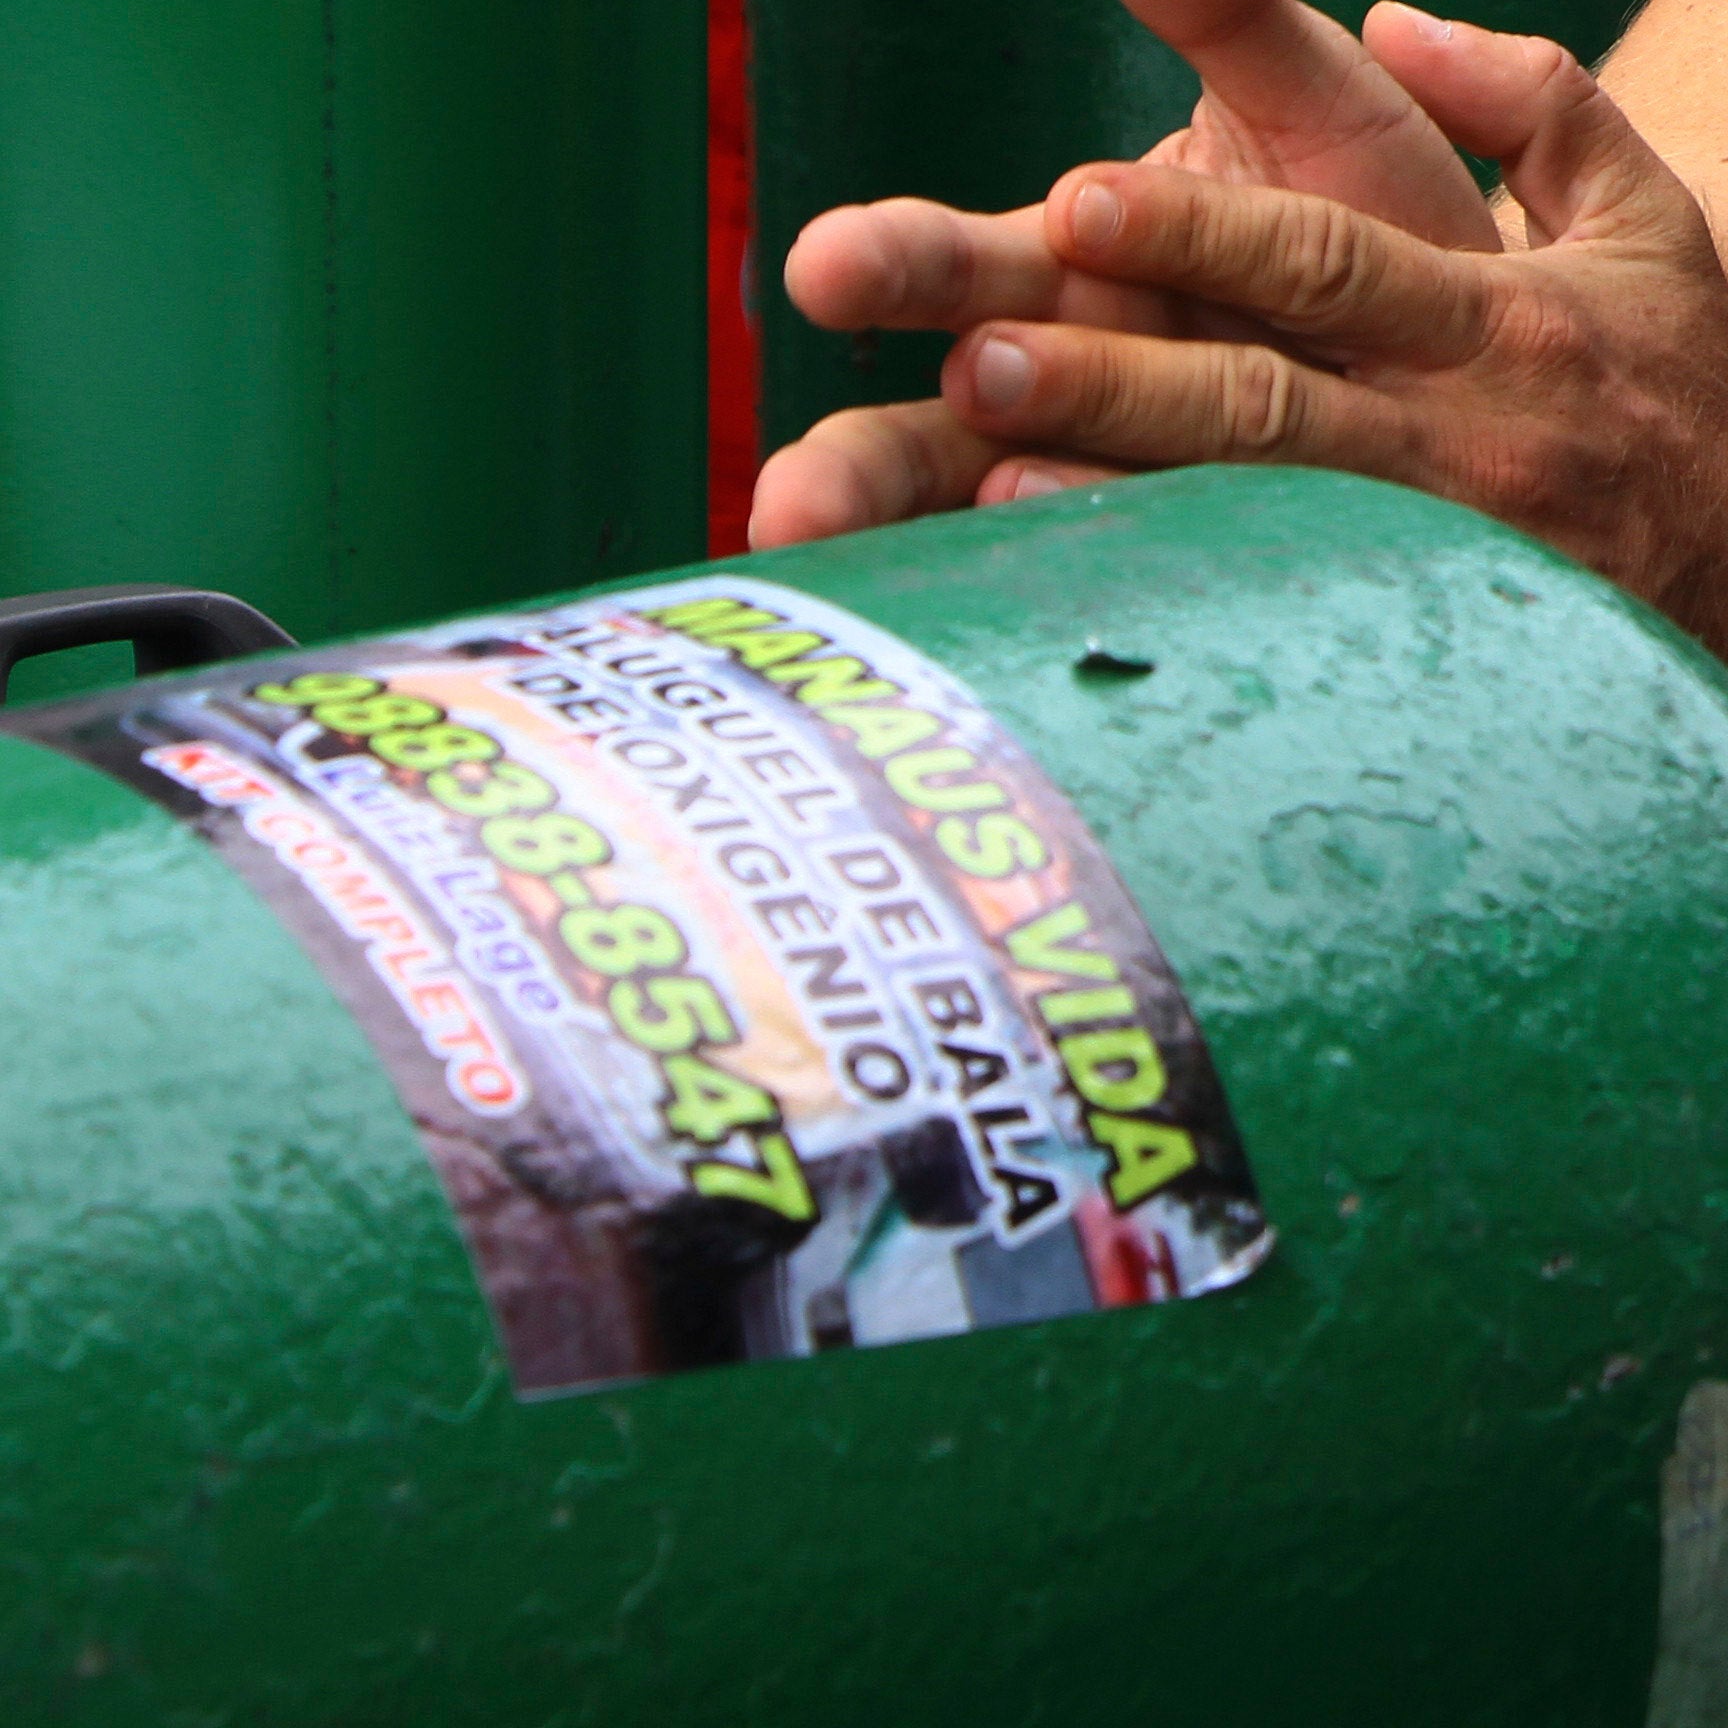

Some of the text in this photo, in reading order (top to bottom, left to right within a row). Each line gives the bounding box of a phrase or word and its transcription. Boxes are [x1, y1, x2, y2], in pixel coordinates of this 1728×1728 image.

[154, 748, 517, 1105] KIT COMPLETO
[247, 671, 818, 1224] 98838-8547
[432, 868, 560, 1015] Lage
[513, 673, 911, 1104] DE OXIGÊNIO
[635, 596, 1197, 1209] MANAUS VIDA
[828, 846, 943, 948] DE
[912, 977, 1061, 1231] BALA
